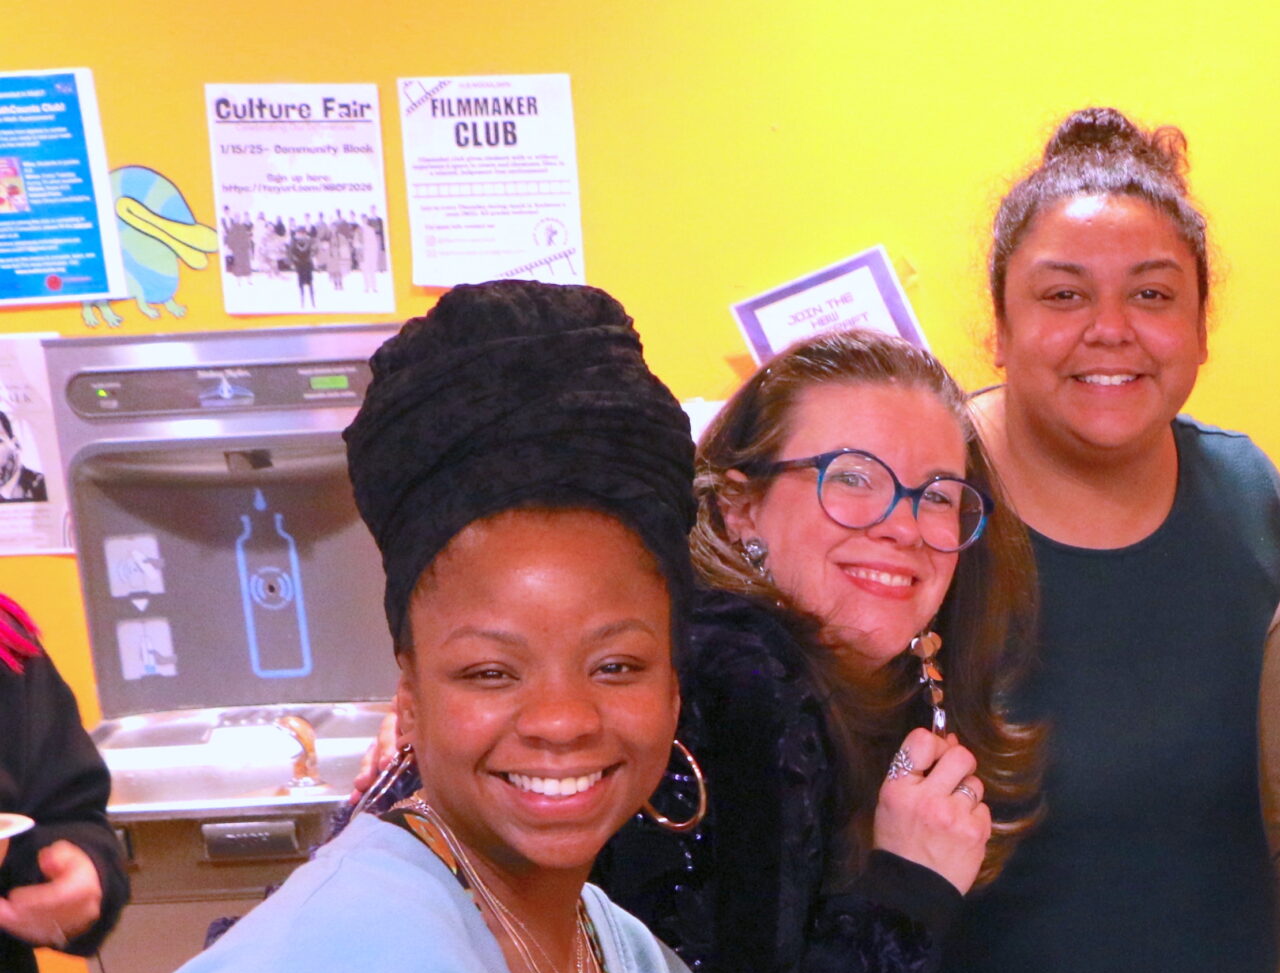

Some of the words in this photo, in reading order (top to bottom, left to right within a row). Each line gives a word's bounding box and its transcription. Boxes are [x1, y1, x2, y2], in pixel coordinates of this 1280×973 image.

[215, 97, 313, 120] Culture
[322, 96, 372, 119] Fair
[430, 96, 539, 118] FILMMAKER
[454, 120, 518, 148] CLUB
[274, 144, 338, 156] Community
[788, 304, 823, 325] JOIN
